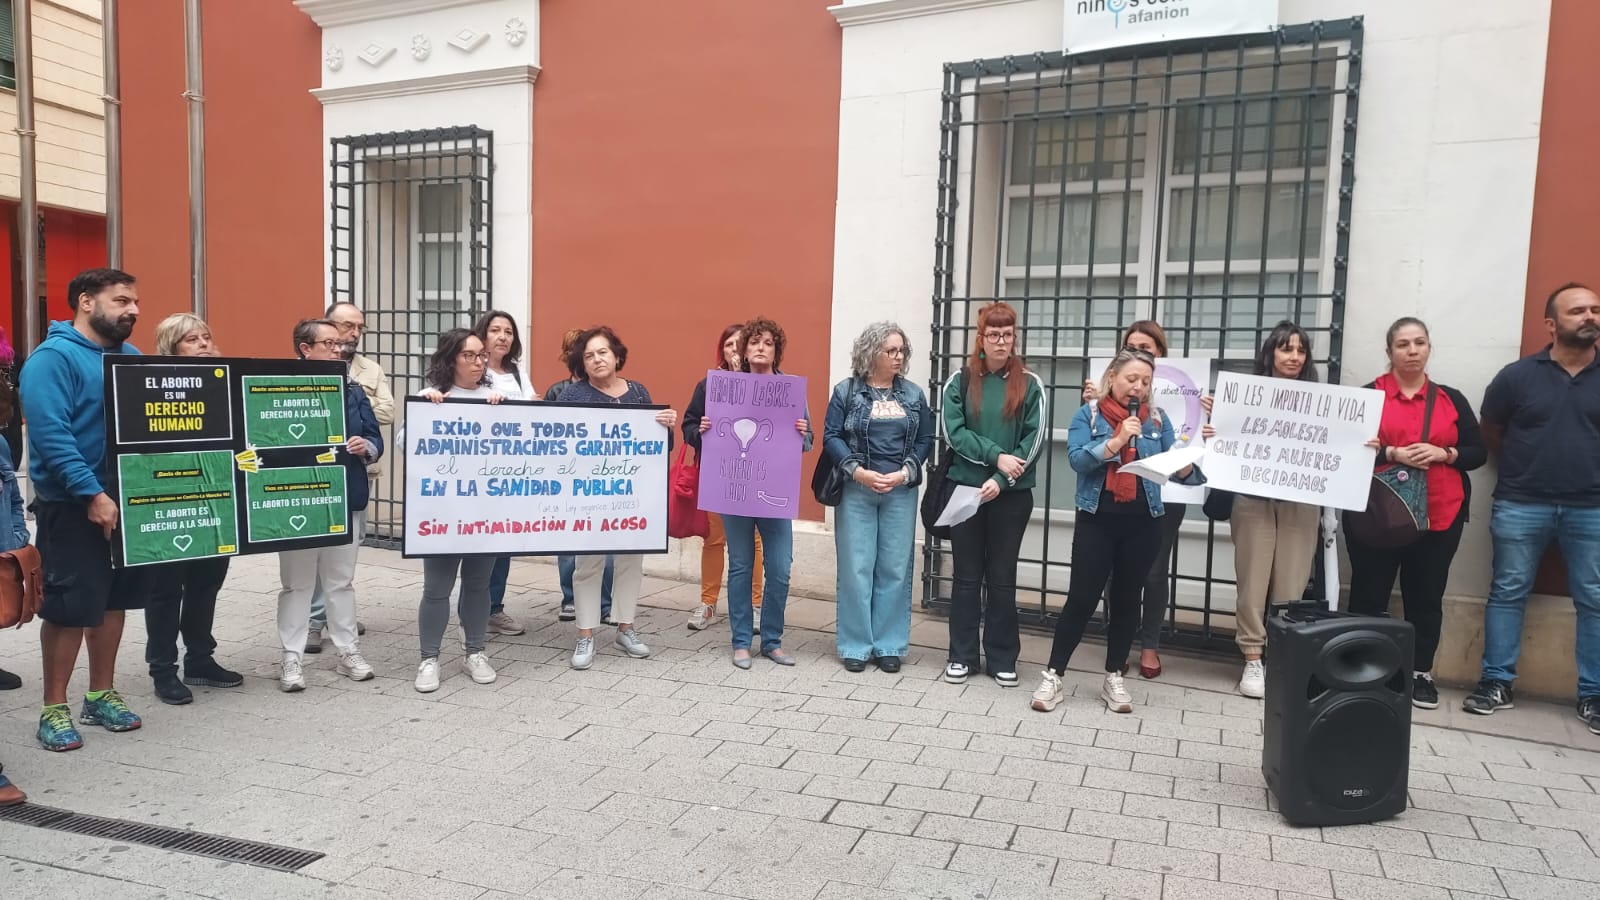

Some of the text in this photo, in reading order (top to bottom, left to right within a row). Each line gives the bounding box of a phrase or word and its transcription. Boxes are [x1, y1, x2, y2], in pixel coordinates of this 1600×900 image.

[1128, 7, 1190, 24] afanion
[145, 377, 203, 389] EL ABORTO
[164, 391, 186, 400] ES UN
[273, 398, 320, 408] EL ABORTO ES
[1222, 381, 1367, 424] NO LES IMPORTA LA VIDA
[145, 401, 206, 416] DERECHO
[260, 409, 331, 419] DERECHO A LA SALUD
[149, 417, 203, 432] HUMANO
[432, 416, 632, 439] EXIJO QUE TODAS LAS
[1240, 416, 1329, 445] LES MOLESTA
[575, 437, 664, 456] GARANTICEN
[1213, 439, 1342, 472] QUE LAS MUJERES
[436, 455, 642, 476] el derecho al aborto
[421, 477, 448, 496] EN
[456, 479, 478, 496] LA
[485, 476, 562, 496] SANIDAD
[1240, 464, 1328, 494] DECIDAMOS
[252, 496, 342, 510] EL ABORTO ES TU DERECHO
[155, 507, 209, 519] EL ABORTO ES
[140, 517, 222, 533] DERECHO A LA SALUD
[417, 518, 449, 536] SIN
[600, 516, 648, 532] ACOSO
